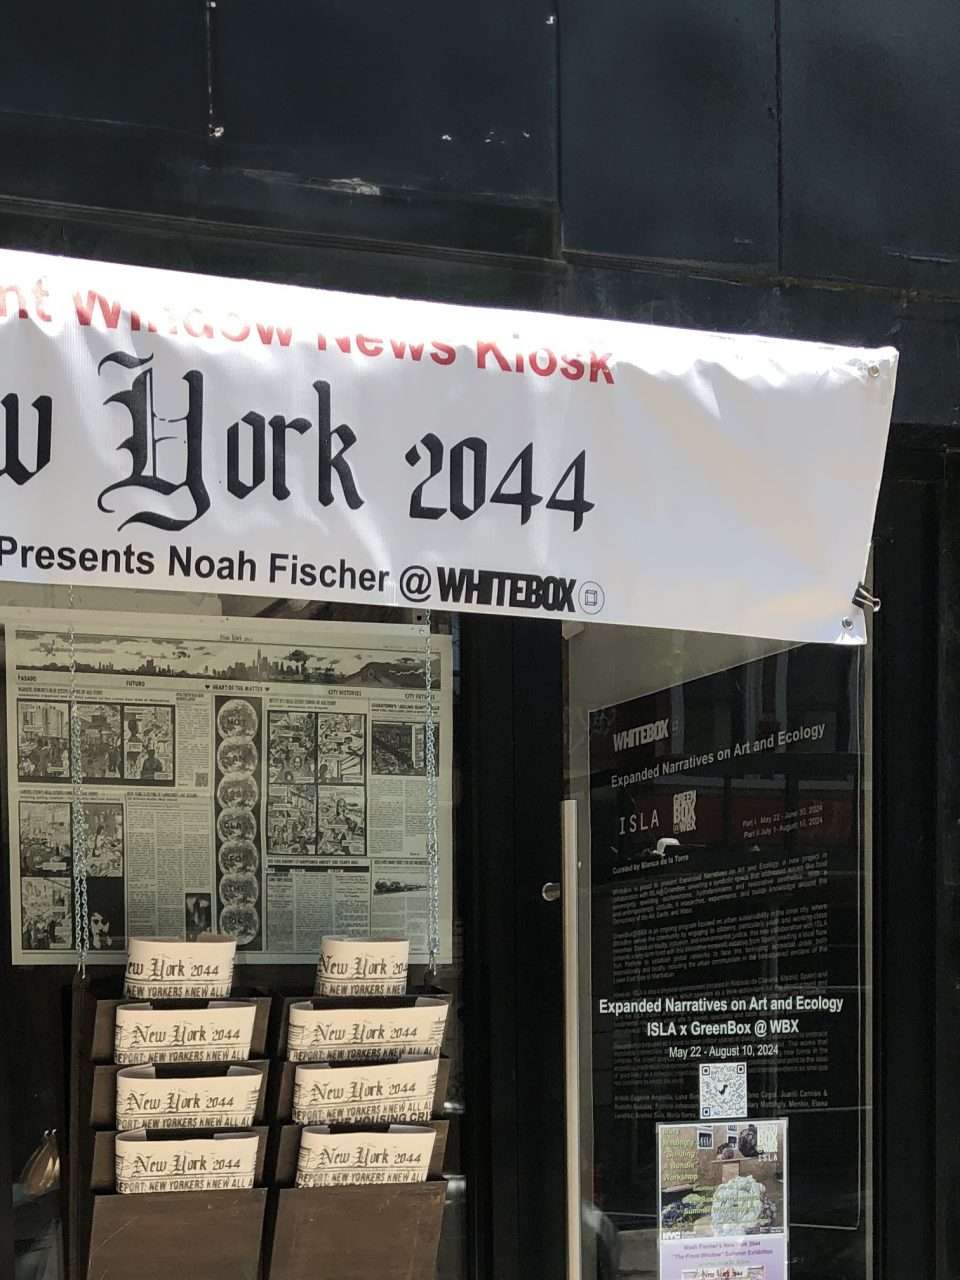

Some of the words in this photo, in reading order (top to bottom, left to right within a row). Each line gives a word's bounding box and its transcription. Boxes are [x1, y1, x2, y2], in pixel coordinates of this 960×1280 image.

[96, 352, 365, 532] York
[405, 432, 596, 533] 2044
[169, 545, 256, 582] Noah
[270, 553, 389, 592] Fischer
[611, 763, 660, 789] Expanded
[662, 751, 715, 777] Narratives
[717, 748, 731, 762] on
[733, 741, 751, 758] Art
[753, 734, 775, 753] and
[778, 721, 826, 747] Ecology
[149, 958, 185, 980] York
[190, 964, 219, 977] 2044
[318, 954, 348, 976] New
[351, 957, 387, 979] York
[599, 998, 662, 1016] Expanded
[665, 996, 728, 1013] Narratives
[731, 1000, 747, 1012] on
[749, 996, 768, 1012] Art
[770, 996, 793, 1011] and
[796, 995, 844, 1013] Ecology
[131, 1025, 167, 1048] New
[169, 1025, 207, 1046] York
[211, 1029, 240, 1041] 2044
[311, 1024, 346, 1046] New
[350, 1024, 385, 1044] York
[390, 1028, 417, 1040] 2044
[647, 1022, 677, 1037] ISLA
[680, 1024, 688, 1037] x
[691, 1020, 752, 1036] GreenBox
[754, 1019, 768, 1037] @
[770, 1019, 800, 1034] WBX
[669, 1046, 688, 1060] May
[690, 1046, 702, 1057] 22
[709, 1045, 740, 1059] August
[742, 1045, 756, 1058] 10,
[757, 1044, 779, 1056] 2024
[126, 1091, 160, 1112] New
[163, 1091, 200, 1113] York
[205, 1096, 234, 1109] 2044
[310, 1083, 344, 1103] New
[347, 1081, 383, 1102] York
[388, 1082, 416, 1095] 2044
[132, 1155, 167, 1177] New
[169, 1154, 207, 1176] York
[212, 1159, 240, 1170] 2044
[317, 1147, 350, 1168] New
[353, 1146, 389, 1169] York
[394, 1152, 422, 1165] 2044
